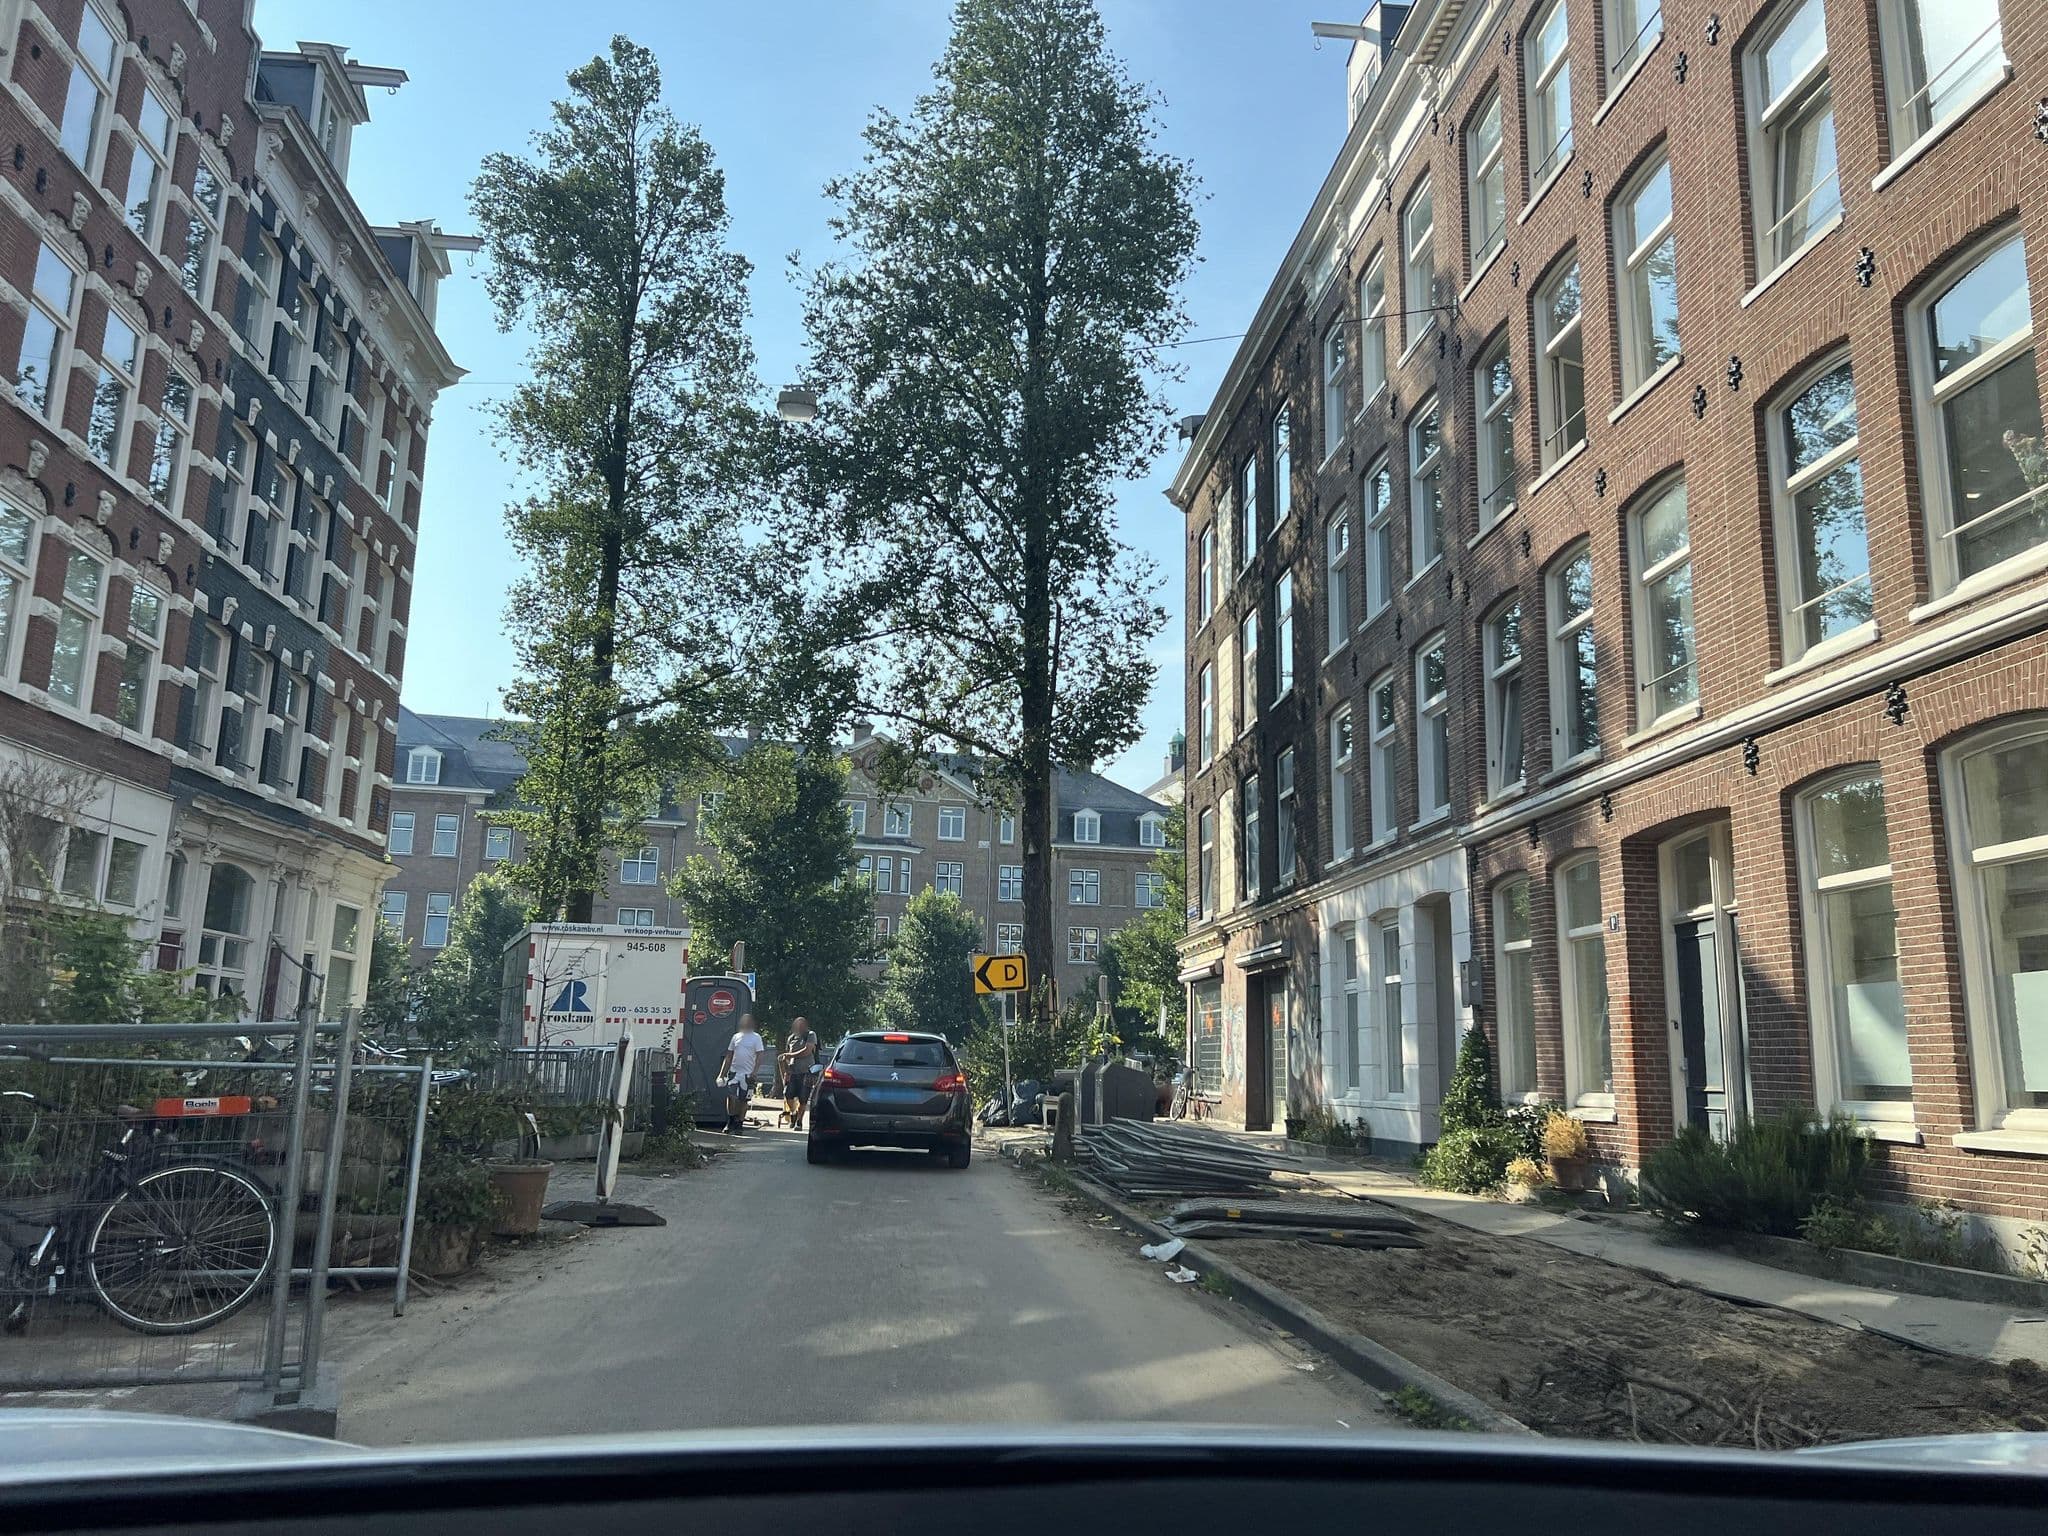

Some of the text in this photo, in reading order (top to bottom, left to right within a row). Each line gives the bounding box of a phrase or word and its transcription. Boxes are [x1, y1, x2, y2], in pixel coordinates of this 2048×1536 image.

[623, 927, 683, 936] verkoop-verhuur
[626, 942, 666, 952] 945-608
[1004, 964, 1018, 981] D
[546, 1013, 594, 1024] roskam
